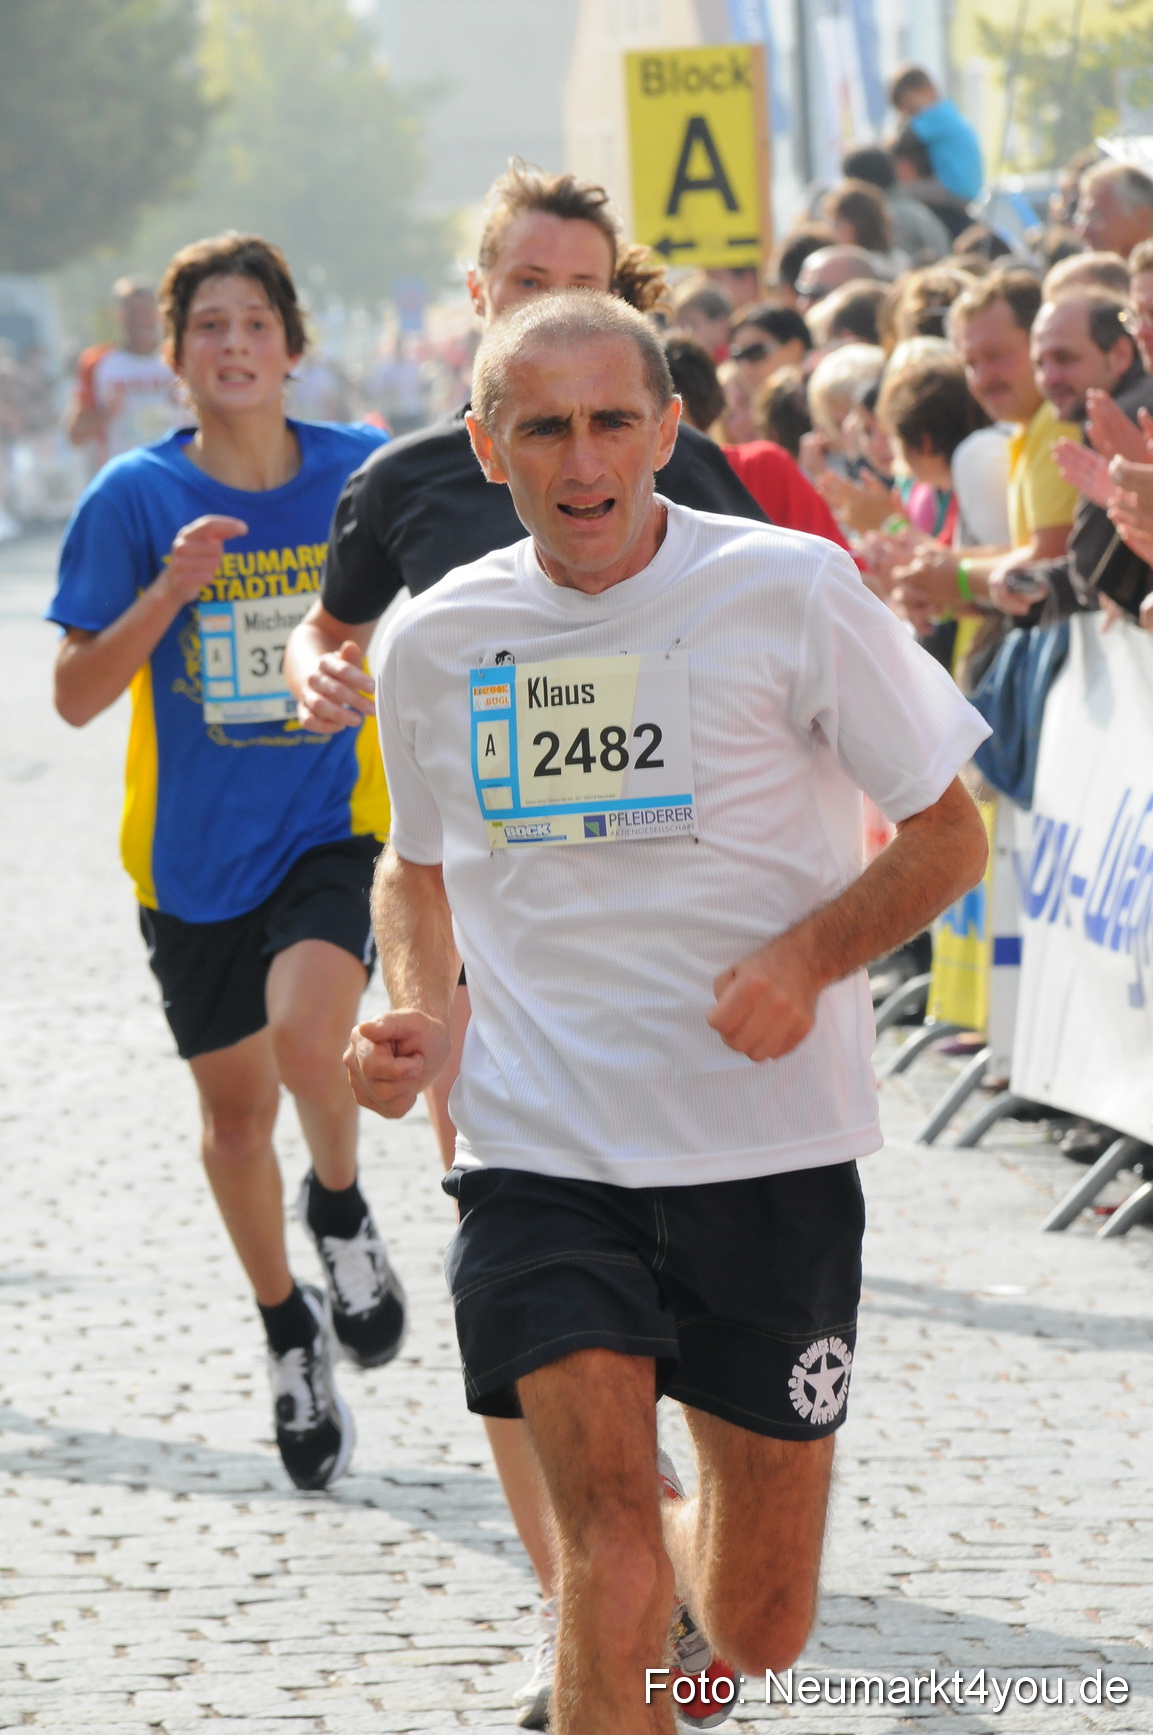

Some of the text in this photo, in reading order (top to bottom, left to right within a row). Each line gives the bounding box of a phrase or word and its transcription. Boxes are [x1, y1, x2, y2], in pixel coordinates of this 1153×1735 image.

[641, 56, 752, 96] Block
[667, 116, 740, 216] A
[527, 676, 595, 709] Klaus
[485, 733, 496, 757] A
[532, 723, 664, 777] 2482
[504, 823, 551, 839] BOCK
[608, 807, 693, 827] PFLEIDERER
